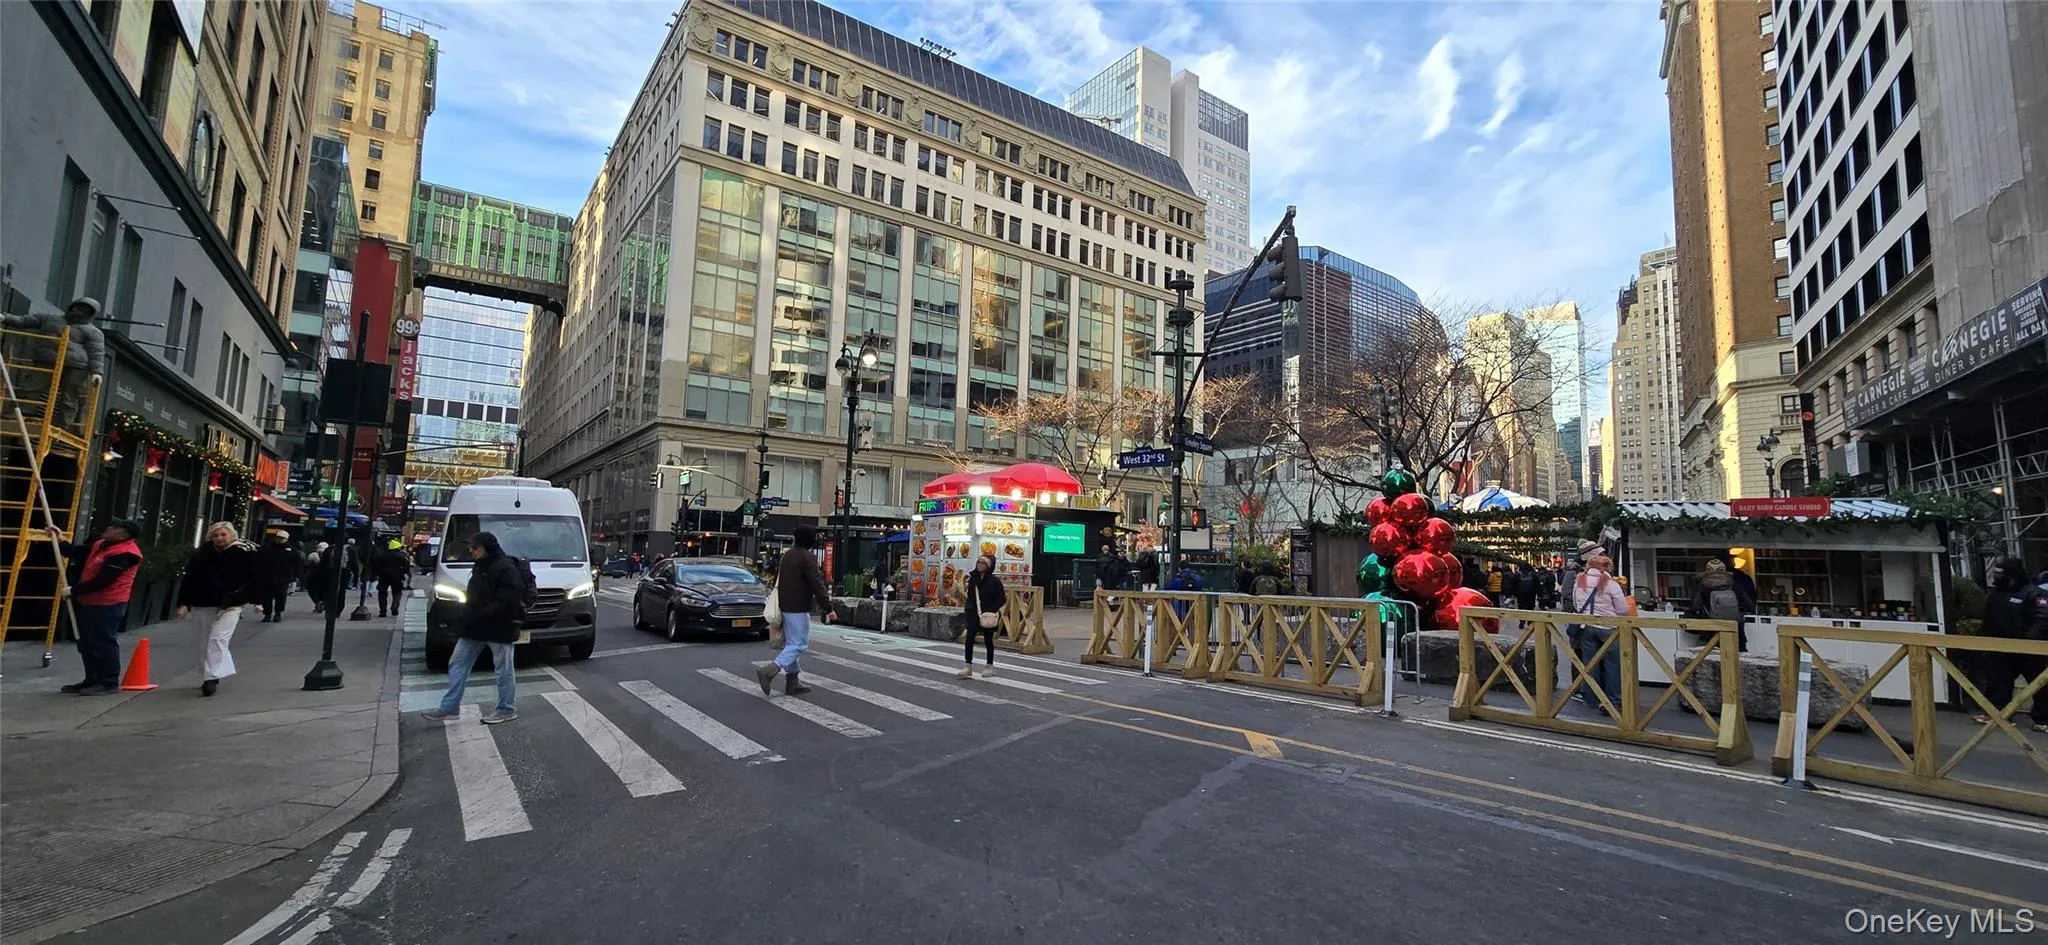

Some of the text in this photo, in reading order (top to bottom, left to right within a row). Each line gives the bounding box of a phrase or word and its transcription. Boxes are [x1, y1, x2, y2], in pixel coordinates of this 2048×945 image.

[1932, 309, 2007, 367] CARNEGIE
[1935, 360, 1965, 383] DINER
[1980, 335, 2009, 359] CAFE
[1858, 369, 1906, 408] CARNEGIE
[1123, 453, 1165, 465] West 32nd St
